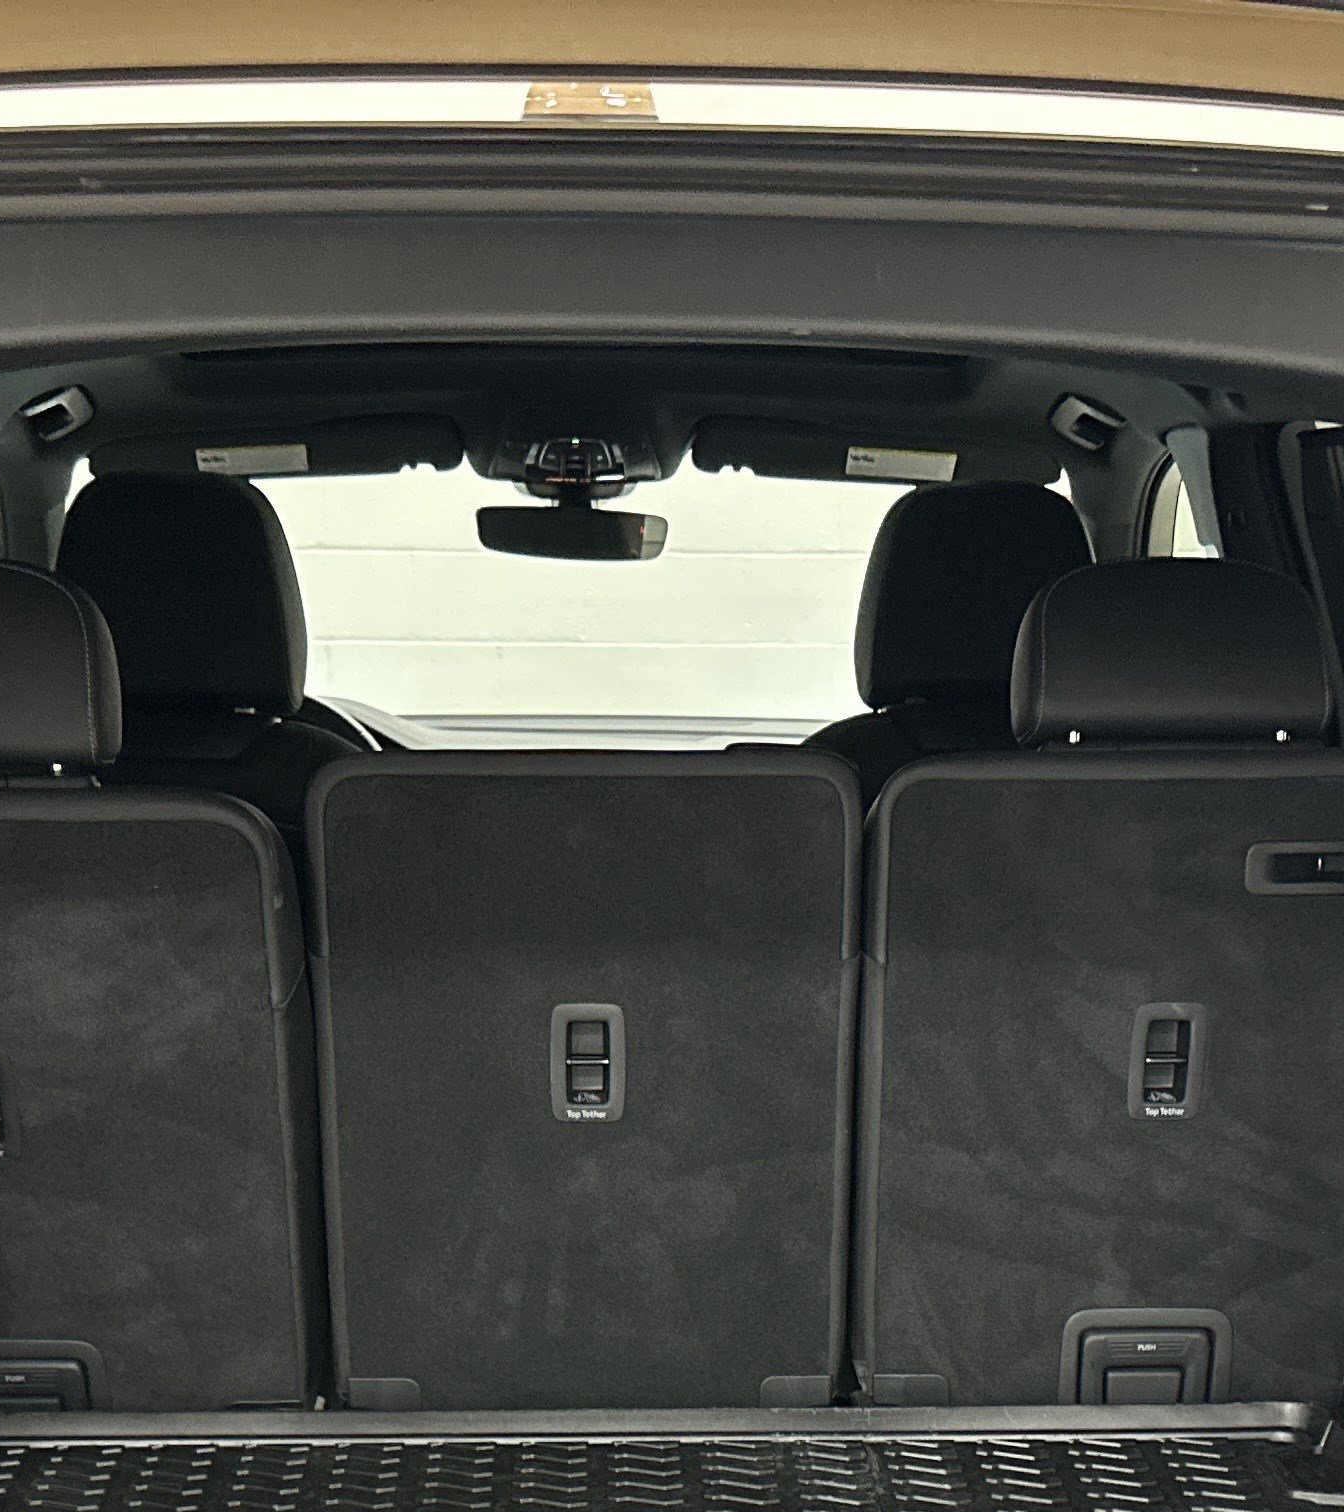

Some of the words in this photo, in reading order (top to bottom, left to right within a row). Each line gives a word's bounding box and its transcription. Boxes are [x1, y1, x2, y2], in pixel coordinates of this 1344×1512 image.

[566, 1109, 581, 1119] Top
[582, 1109, 607, 1119] Tether
[1145, 1107, 1159, 1117] Top
[1160, 1107, 1185, 1116] Tether
[1137, 1343, 1157, 1351] PUSH
